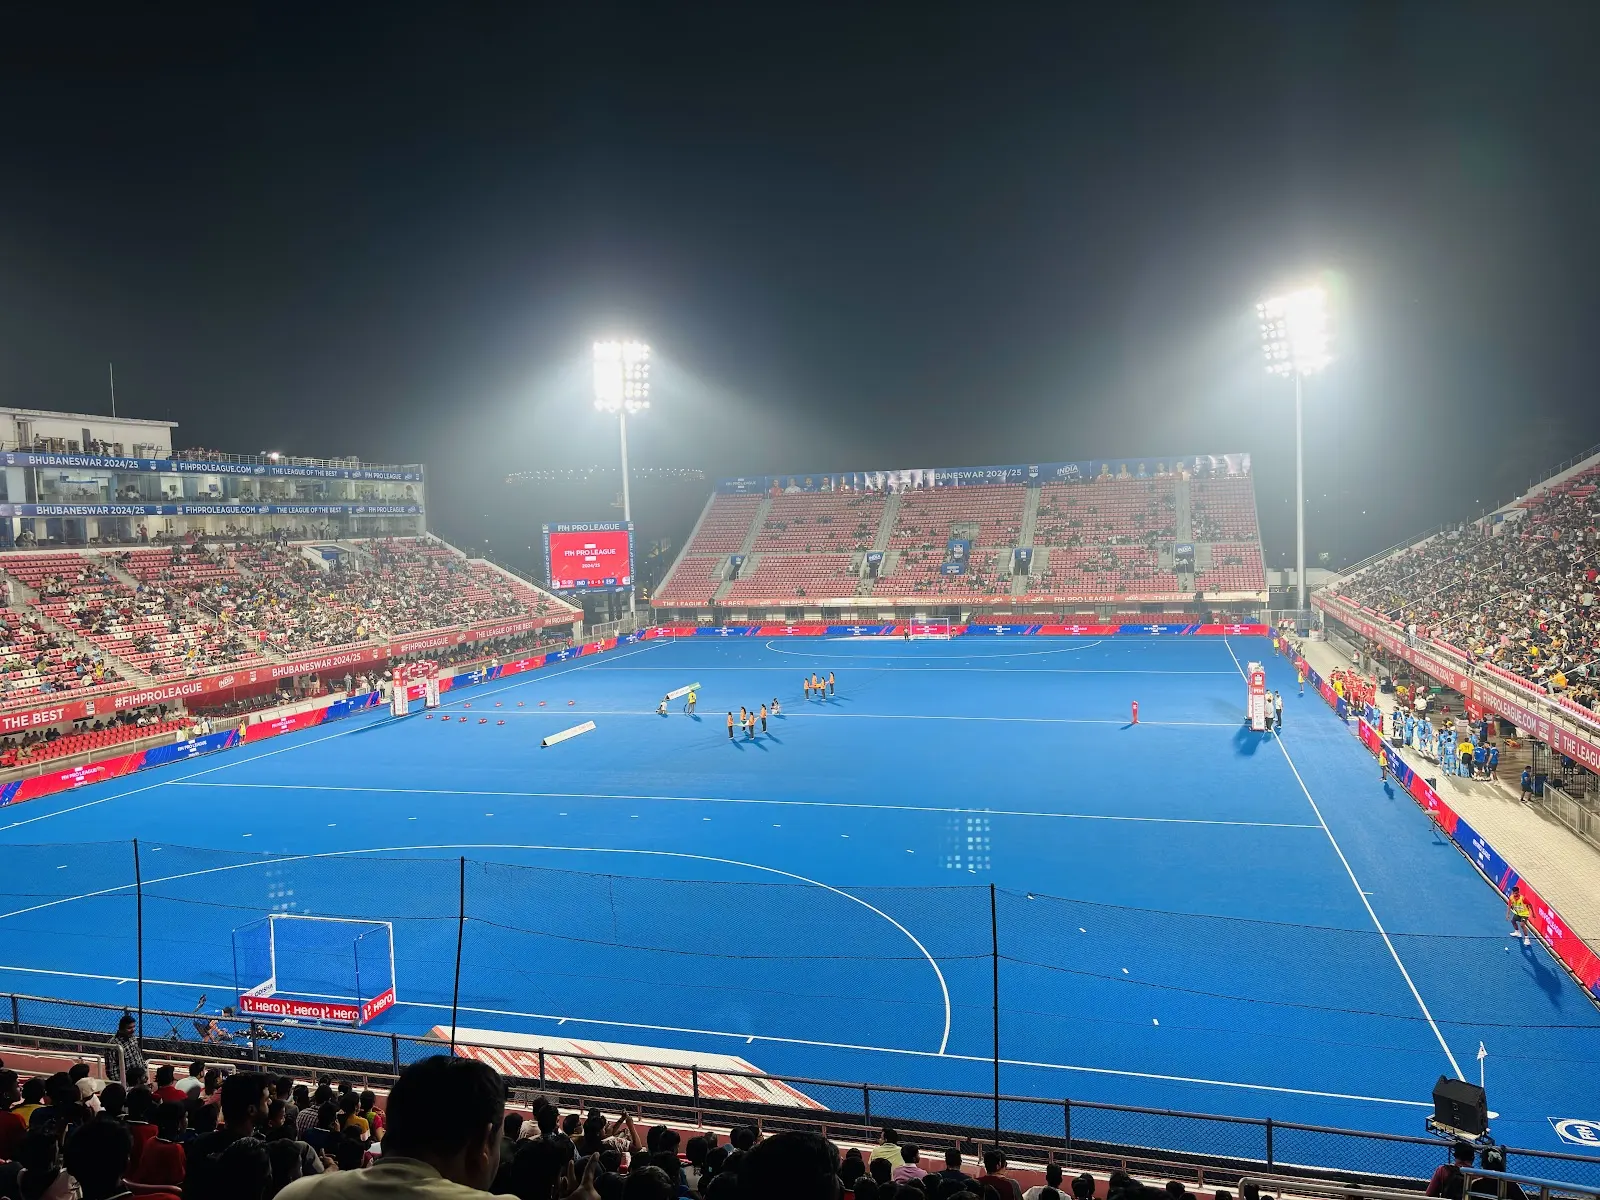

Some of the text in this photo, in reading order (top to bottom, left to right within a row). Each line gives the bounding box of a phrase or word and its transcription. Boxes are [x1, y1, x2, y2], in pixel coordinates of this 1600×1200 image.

[28, 455, 102, 467] BHUBANESWAR
[104, 458, 138, 469] 2024/25
[180, 462, 252, 474] FIHPROLEAGUE.COM
[918, 468, 1022, 480] HUBANESWAR 2024/25
[1057, 466, 1078, 476] INDIA
[36, 506, 145, 515] BHUBANESWAR 2024/25
[486, 628, 505, 637] LEAGUE
[401, 637, 448, 652] #FIHPROLEAGUE
[272, 653, 361, 677] BHUBANESWAR 2024/25
[115, 675, 234, 708] #FIHPROLEAGUE INDIA
[1483, 692, 1537, 732] FIHPROLEAGUE.COM
[3, 708, 64, 730] THE BEST
[1563, 736, 1576, 756] THE
[255, 1002, 280, 1012] Hero
[373, 994, 392, 1012] Hero
[294, 1006, 319, 1015] Hero
[334, 1010, 359, 1019] Hero
